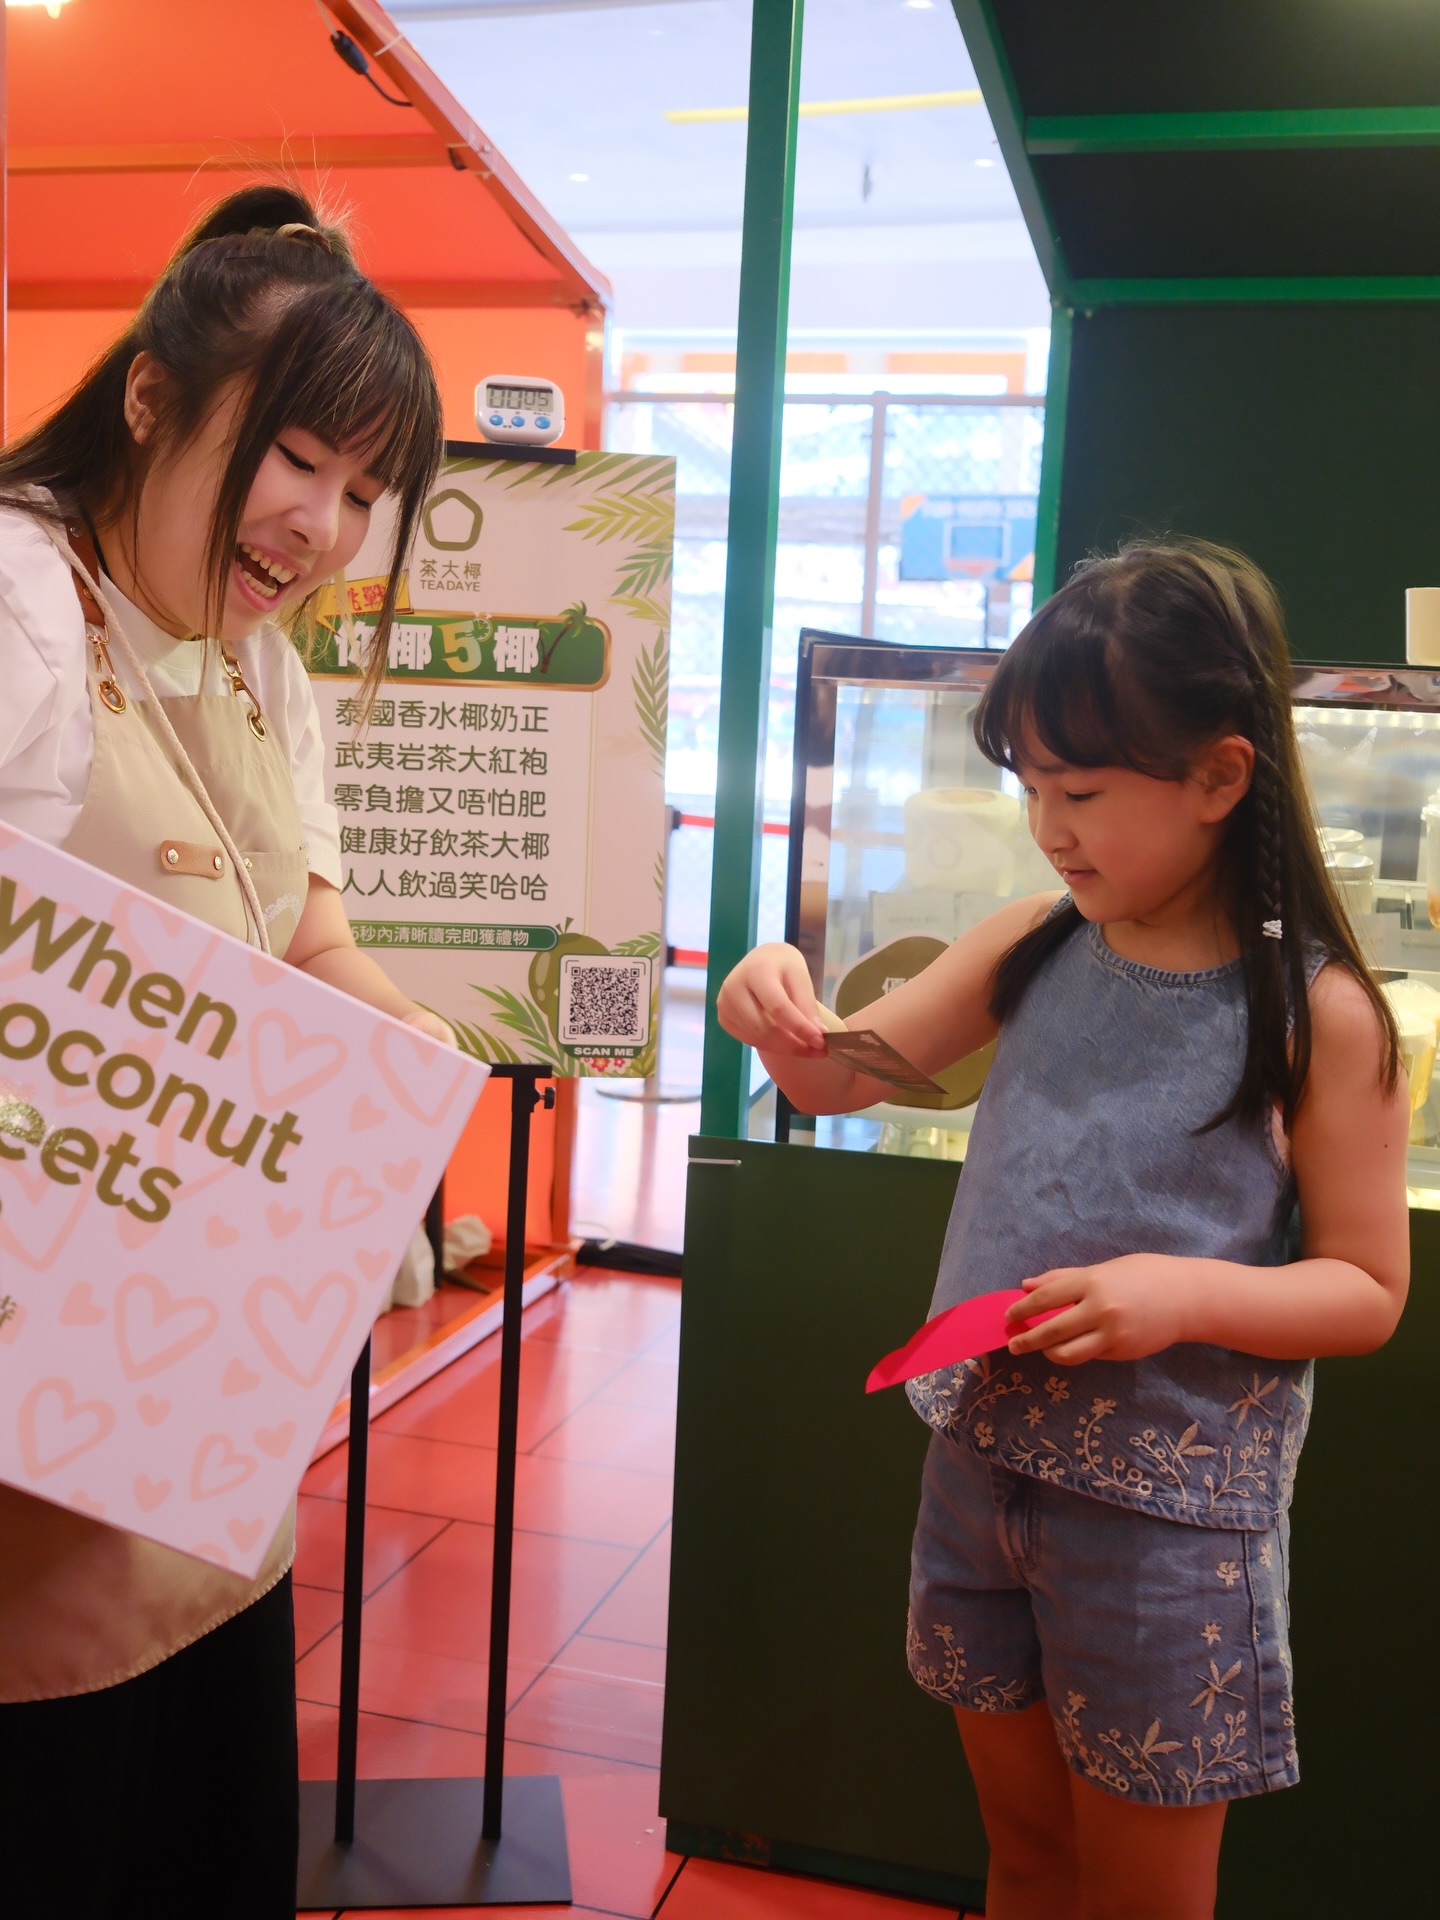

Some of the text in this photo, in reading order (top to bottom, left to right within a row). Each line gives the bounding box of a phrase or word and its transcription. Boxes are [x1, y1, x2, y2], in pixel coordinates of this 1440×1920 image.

[420, 558, 482, 580] 茶大椰
[420, 580, 481, 592] TEADAYE
[335, 697, 549, 733] 泰國香水椰奶正
[335, 741, 548, 776] 武夷岩茶大紅袍
[334, 783, 547, 818] 零負擔又唔怕肥
[339, 825, 550, 860] 健康好飲茶大椰
[339, 868, 549, 901] 人人飲過笑哈哈
[0, 876, 237, 1061] When
[574, 1047, 634, 1057] SCAN ME
